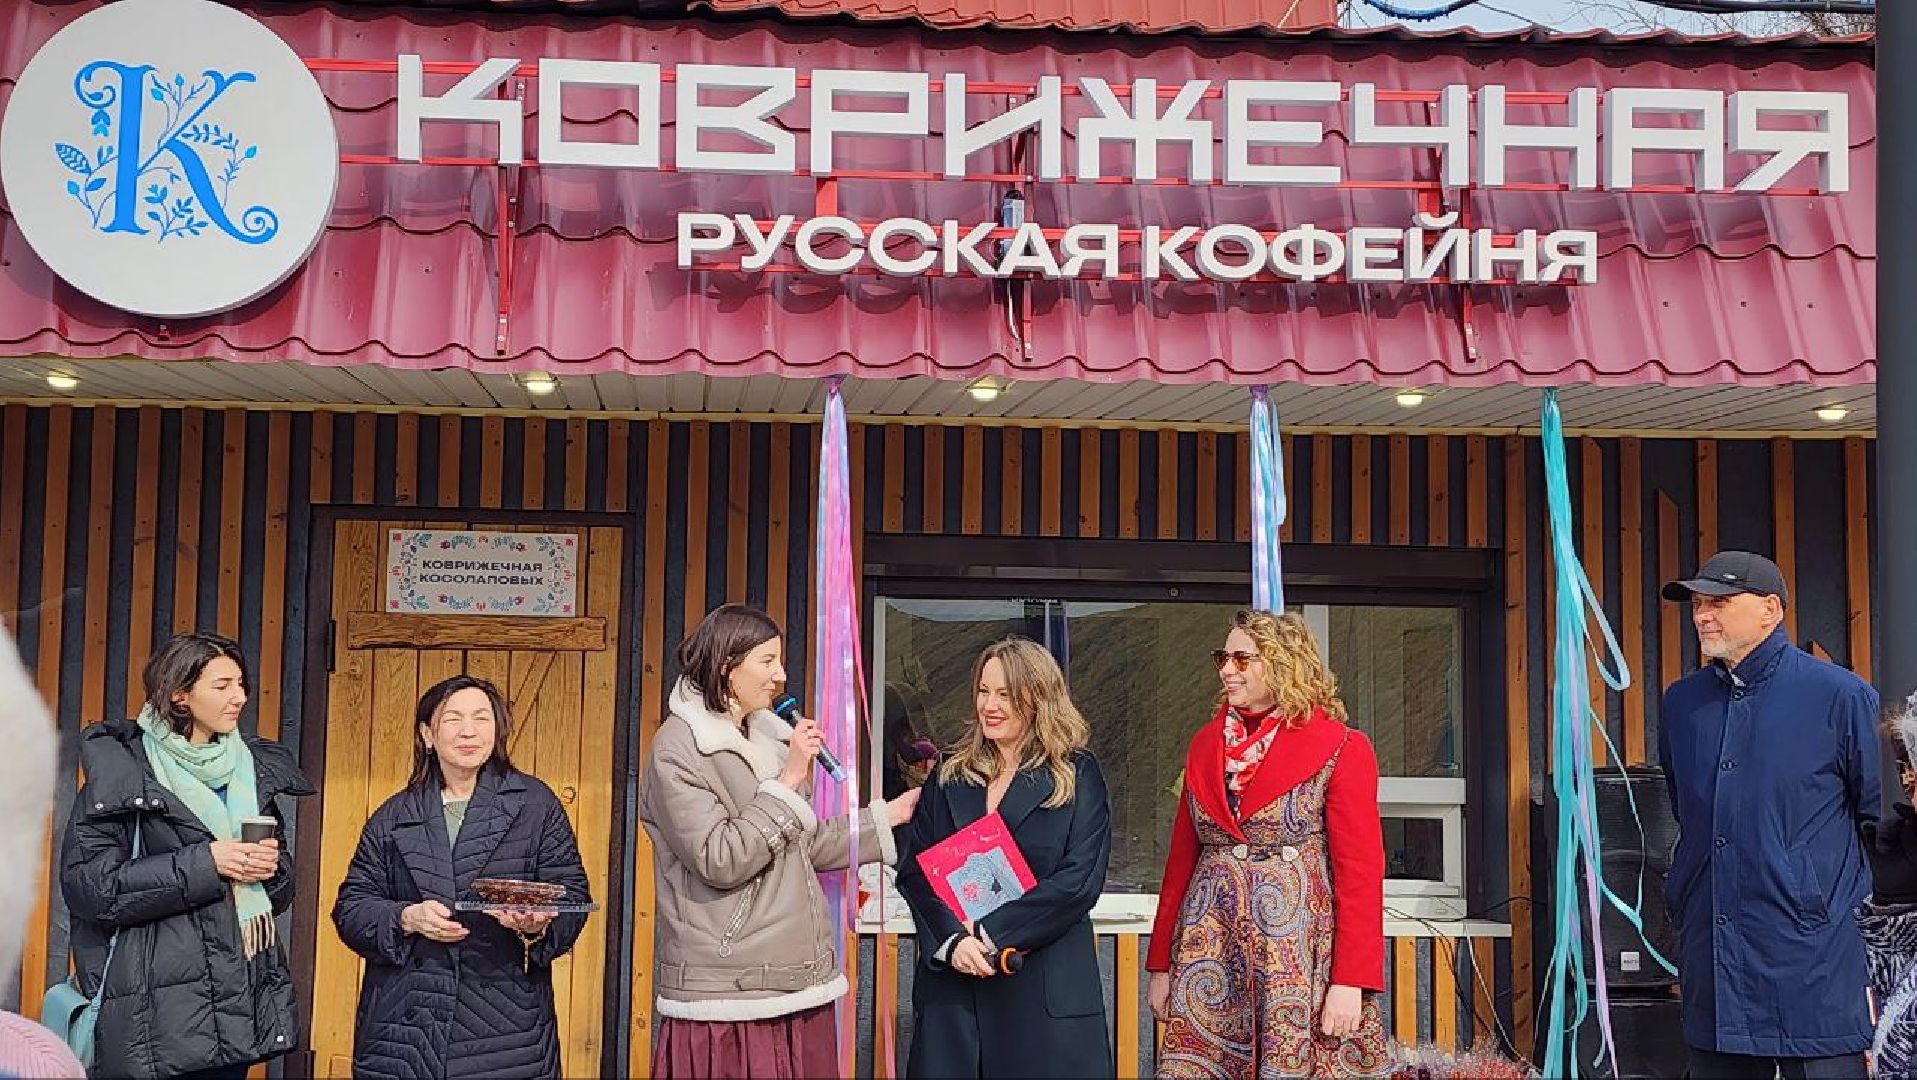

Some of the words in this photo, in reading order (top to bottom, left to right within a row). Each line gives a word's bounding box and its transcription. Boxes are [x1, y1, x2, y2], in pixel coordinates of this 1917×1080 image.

[397, 54, 1849, 194] КОВРИЖЕЧНАЯ
[677, 212, 1119, 279] РУССКАЯ
[1141, 211, 1598, 284] КОФЕЙНЯ
[419, 574, 544, 586] КОСОЛАПОВЫХ
[422, 560, 543, 573] КОВРИЖЕЧНАЯ
